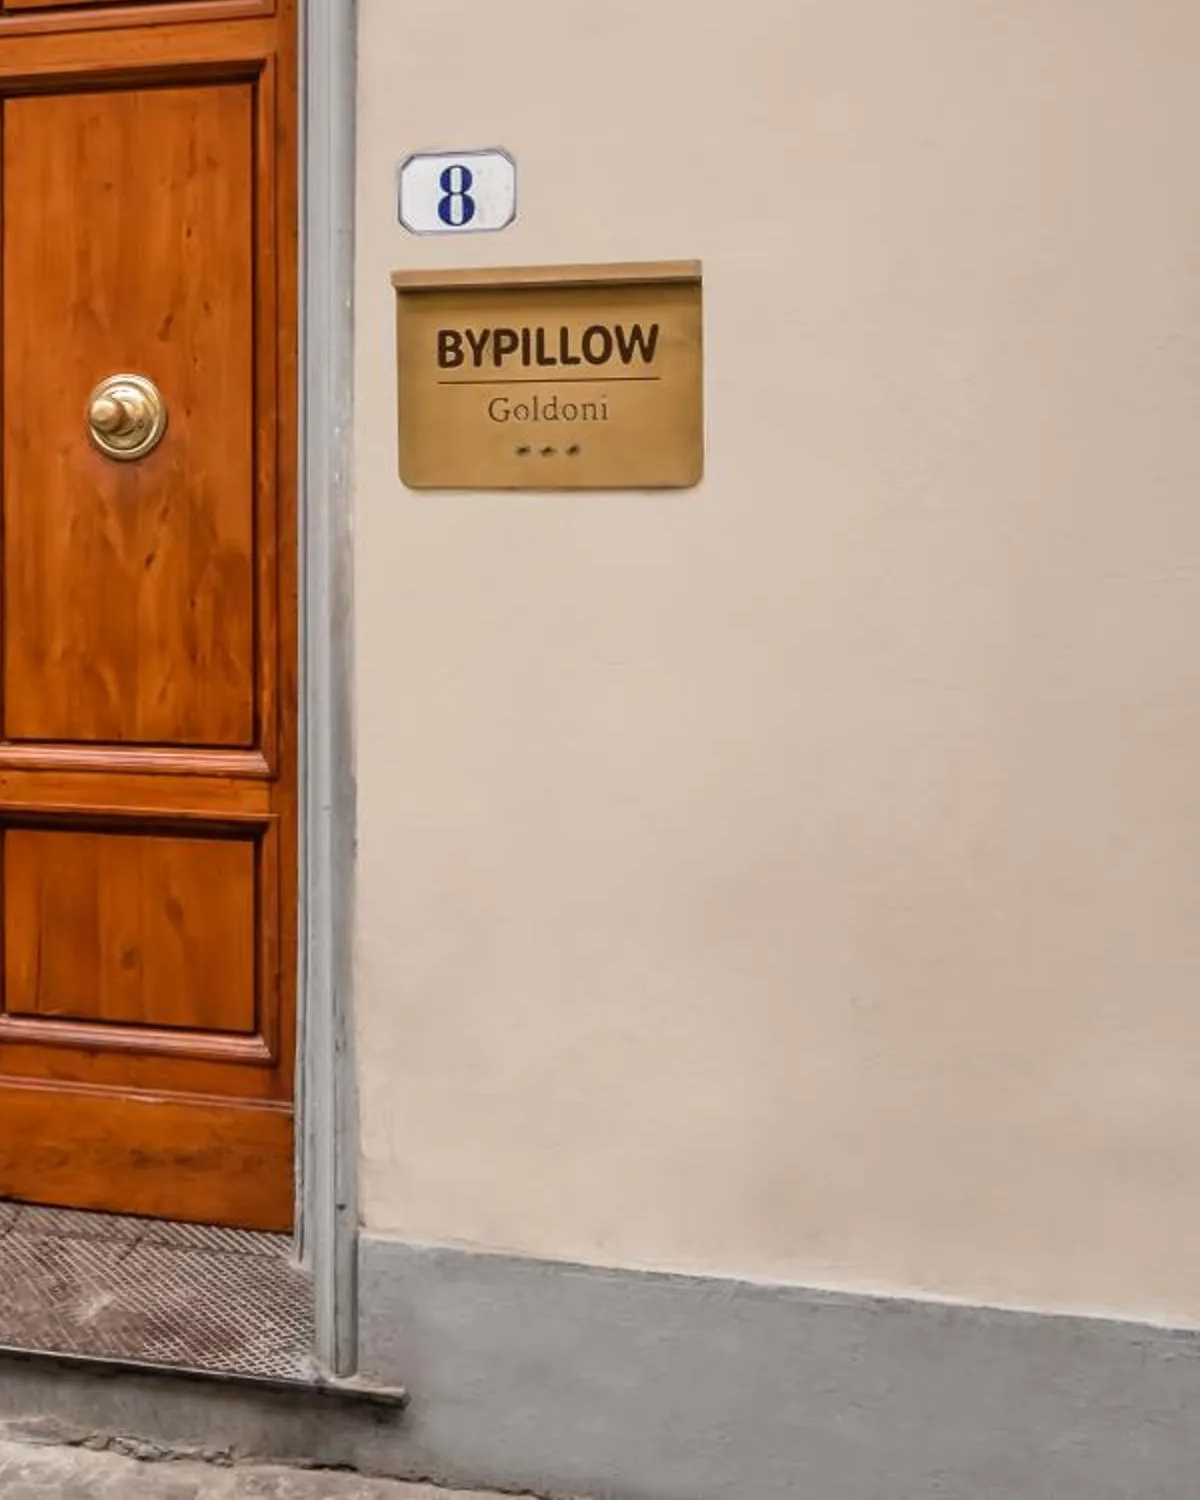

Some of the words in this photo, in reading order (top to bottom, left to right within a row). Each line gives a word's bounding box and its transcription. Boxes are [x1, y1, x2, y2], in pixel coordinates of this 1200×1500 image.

[437, 164, 476, 227] 8
[437, 323, 660, 369] BYPILLOW
[488, 395, 609, 423] Goldoni
